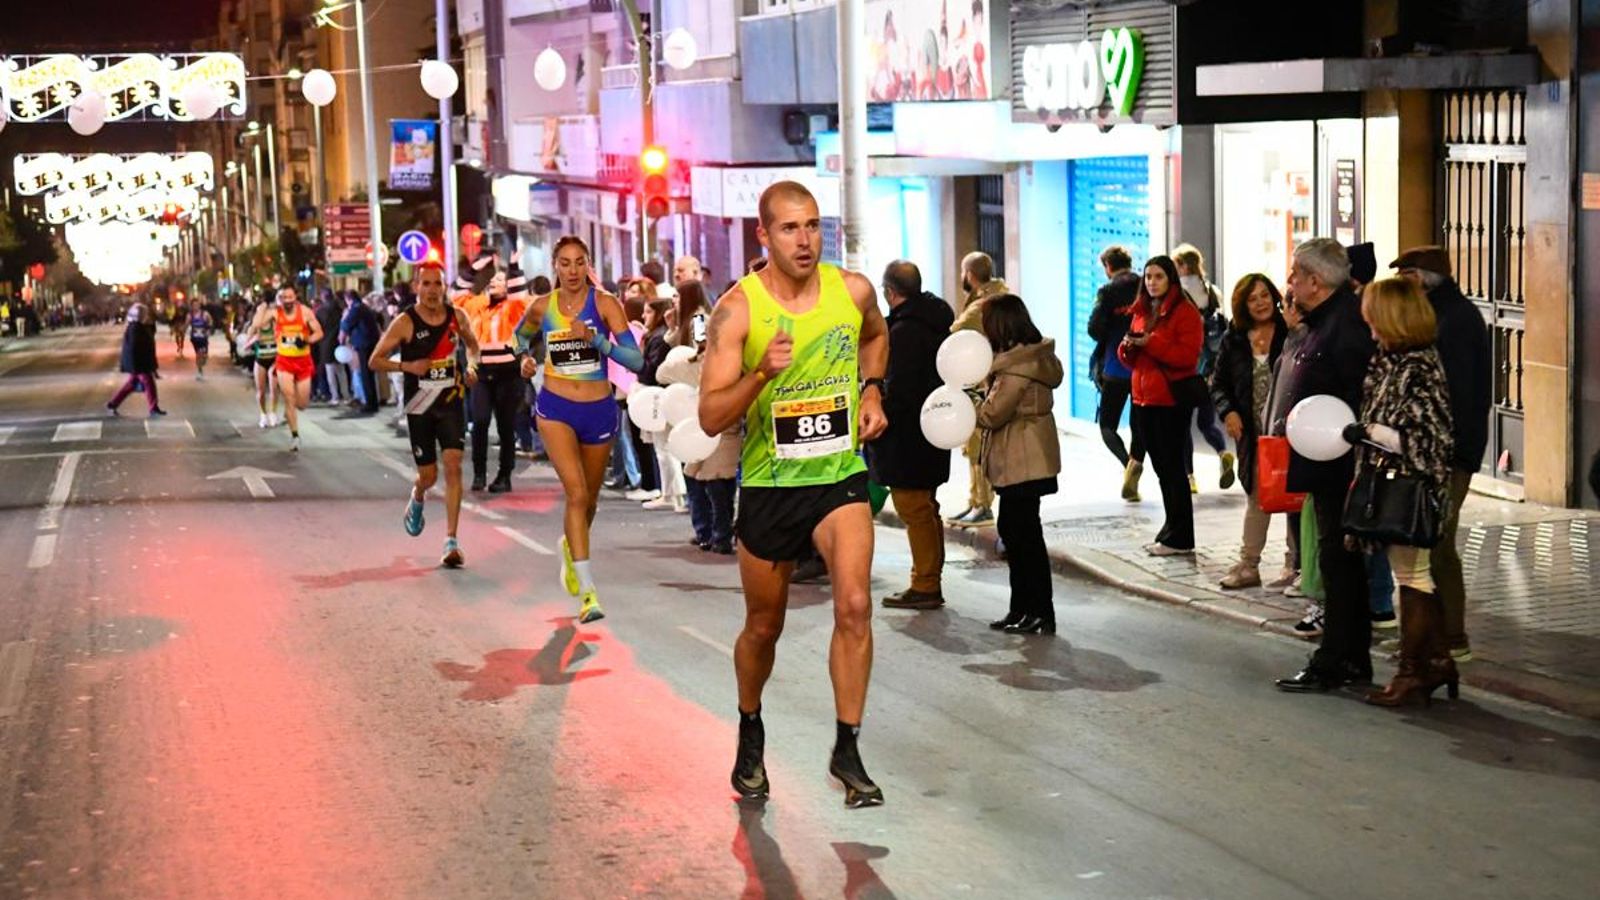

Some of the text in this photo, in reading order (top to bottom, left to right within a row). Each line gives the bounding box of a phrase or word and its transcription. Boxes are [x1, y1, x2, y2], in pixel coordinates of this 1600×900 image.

[568, 352, 581, 361] 34
[429, 367, 447, 380] 92
[797, 413, 832, 437] 86
